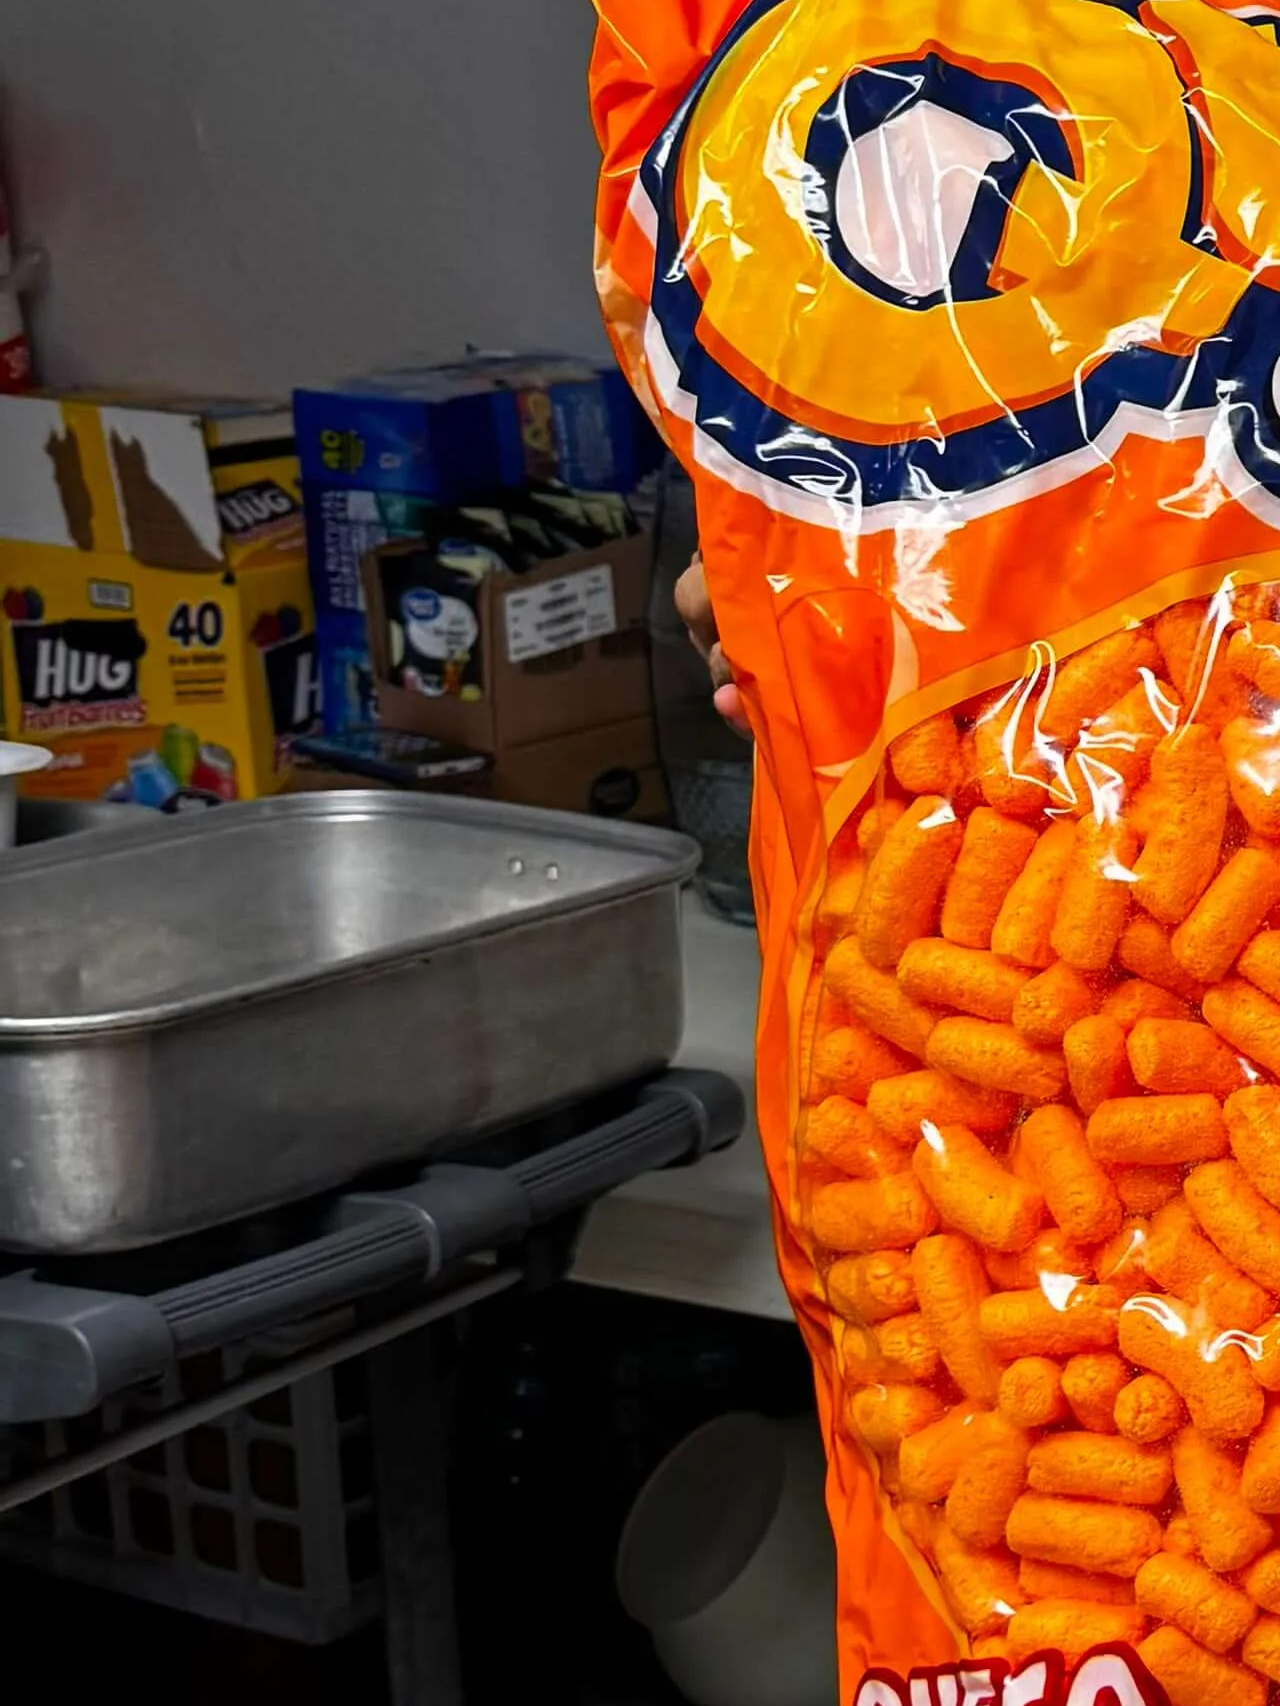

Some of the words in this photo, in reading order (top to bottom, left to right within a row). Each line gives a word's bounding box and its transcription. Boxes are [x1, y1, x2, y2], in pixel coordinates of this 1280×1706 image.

[219, 488, 293, 529] HUG
[167, 600, 223, 647] 40
[34, 638, 133, 699] HUG
